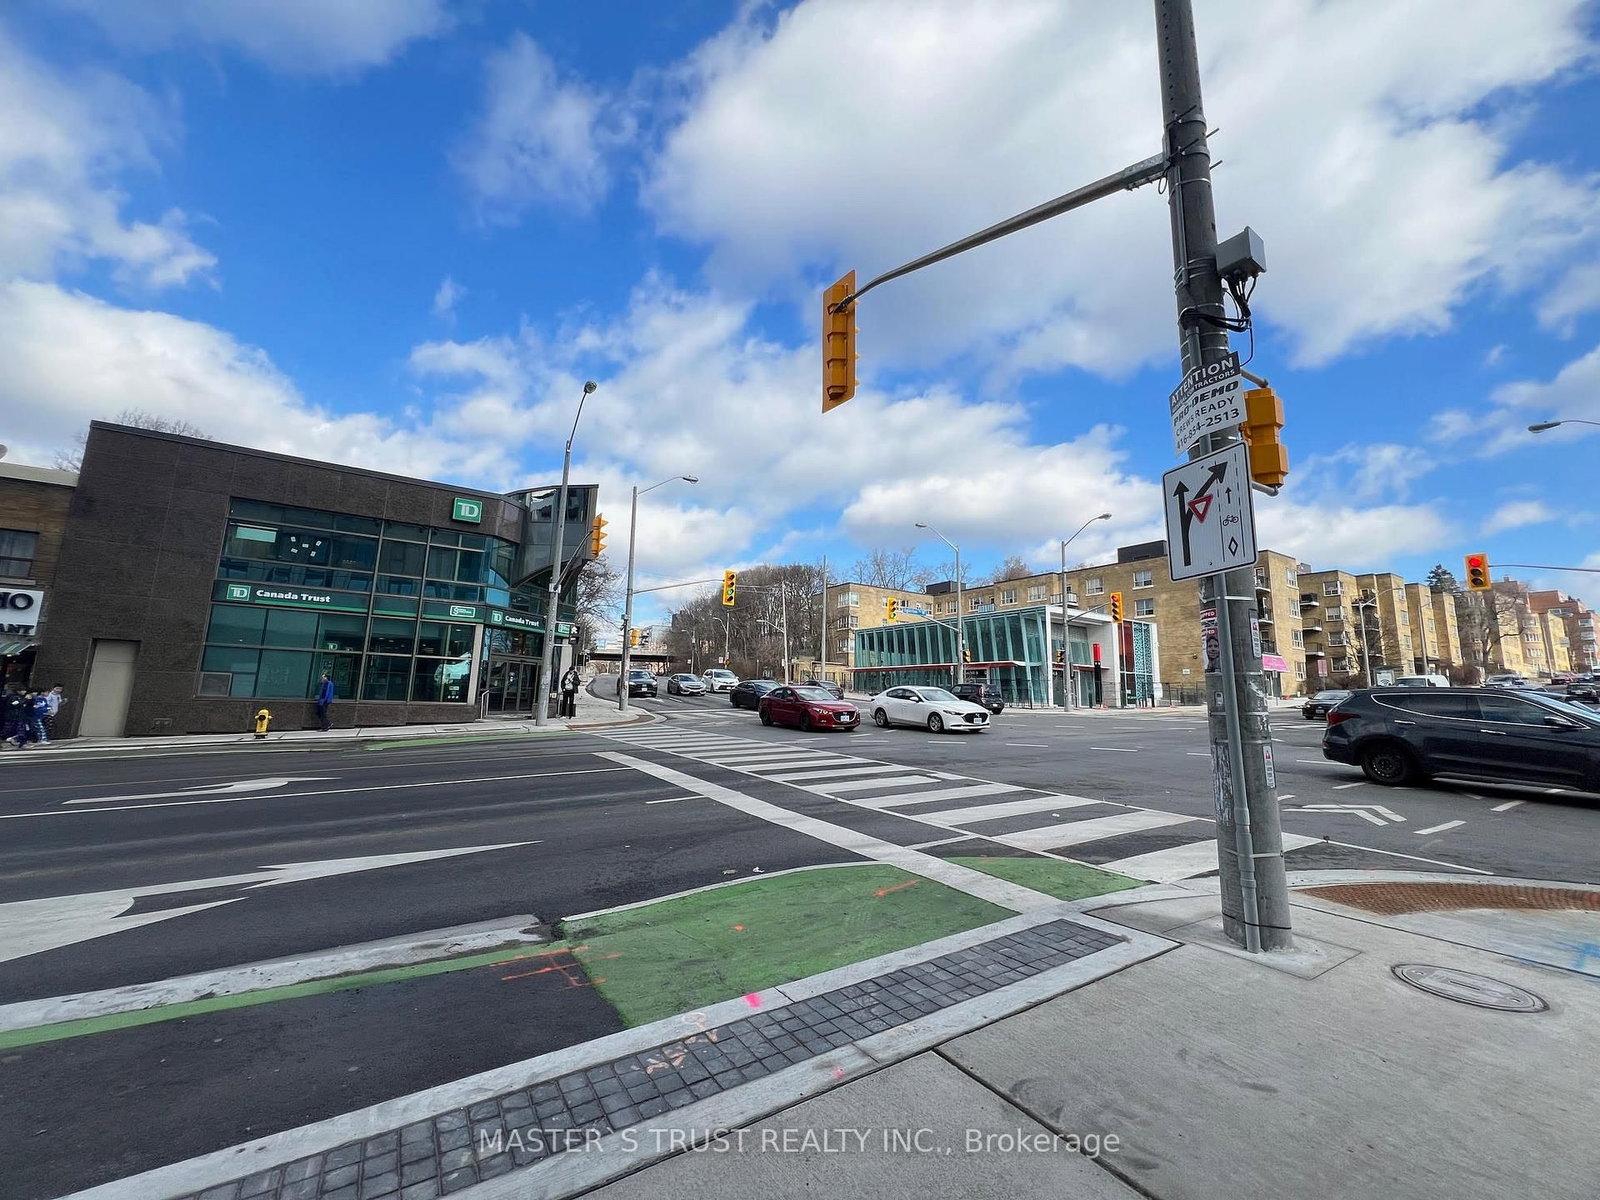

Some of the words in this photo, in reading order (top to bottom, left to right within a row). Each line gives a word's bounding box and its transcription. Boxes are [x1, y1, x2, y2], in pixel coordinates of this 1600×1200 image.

[1171, 357, 1234, 407] ATTENTION
[1195, 396, 1235, 417] READY
[457, 502, 479, 517] TD
[230, 587, 248, 598] TD
[256, 590, 298, 600] Canada
[301, 594, 331, 603] Trust
[505, 615, 525, 625] Canada
[525, 619, 540, 627] Trust
